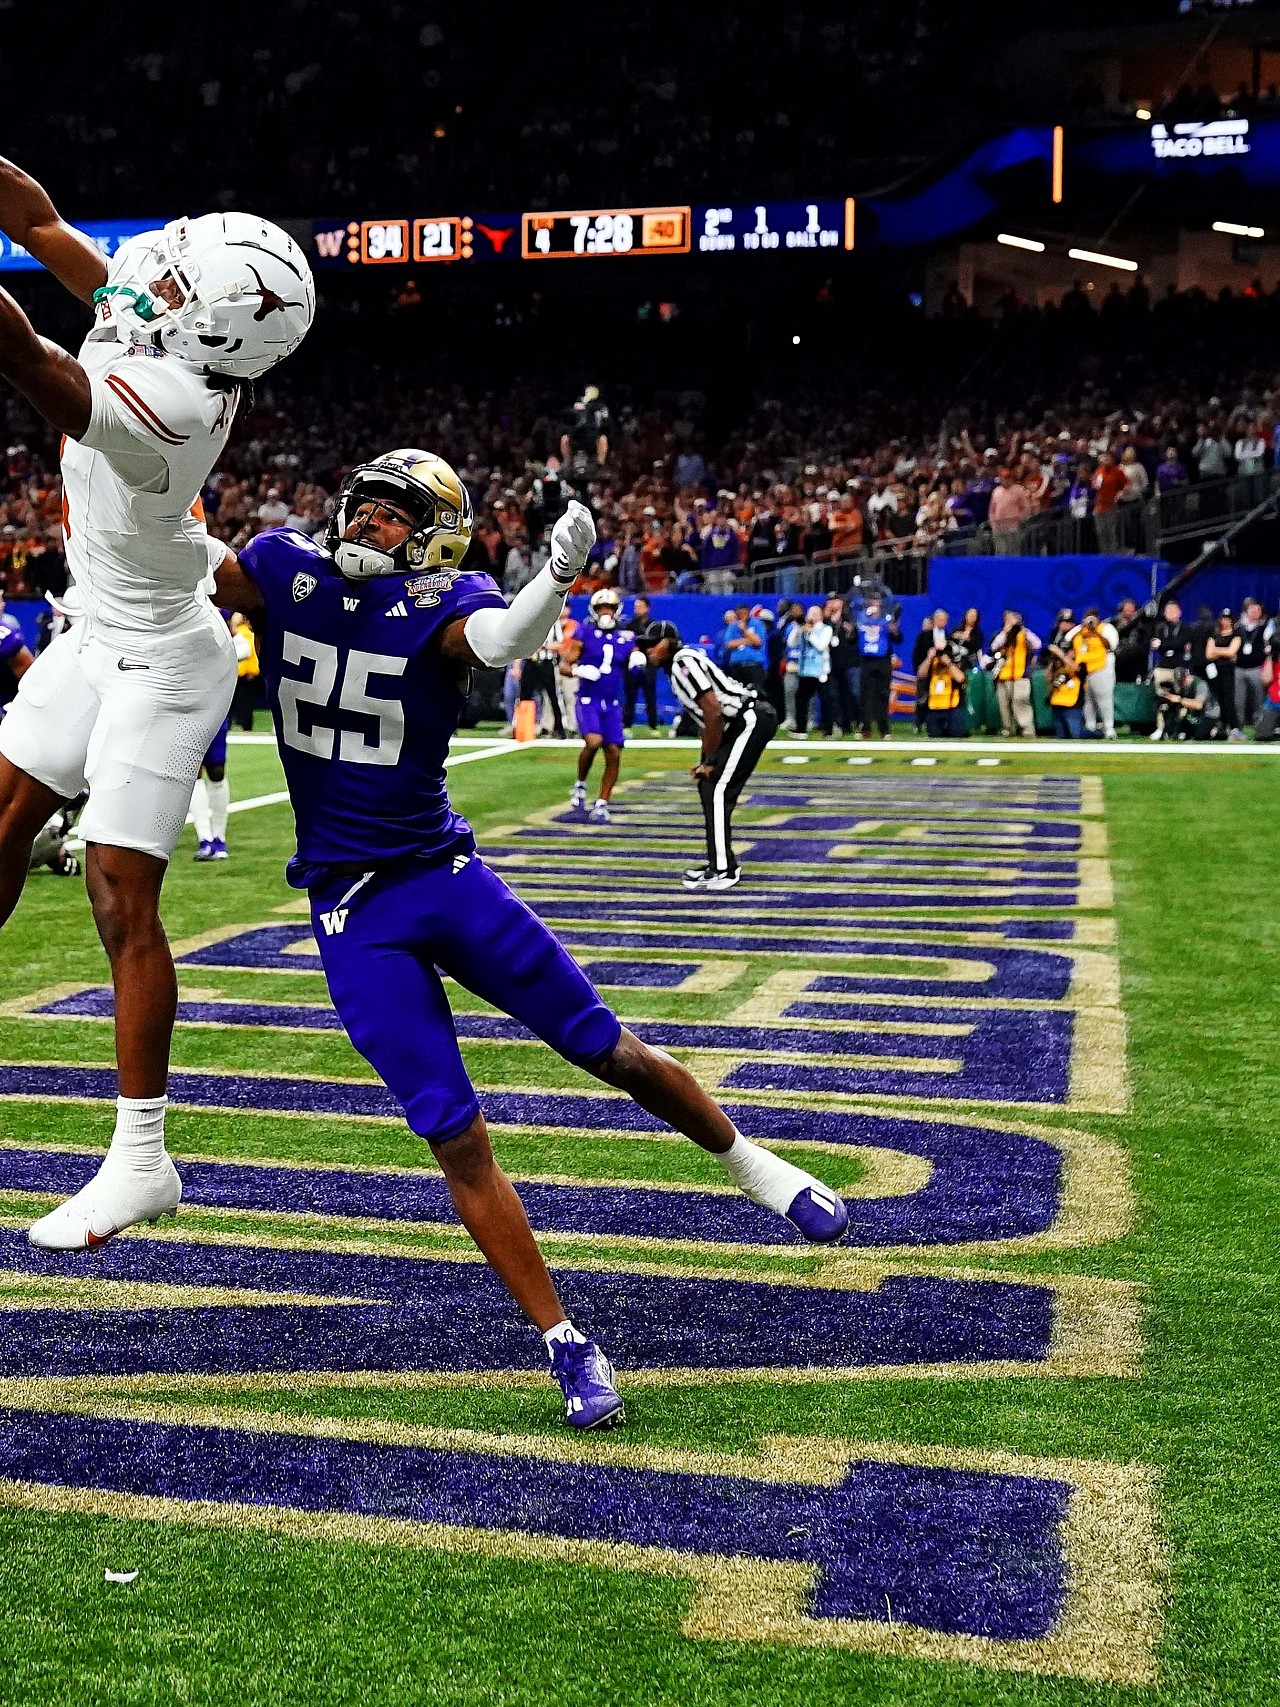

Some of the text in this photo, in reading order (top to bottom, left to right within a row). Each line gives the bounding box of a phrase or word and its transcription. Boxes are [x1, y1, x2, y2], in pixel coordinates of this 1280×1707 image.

[1152, 135, 1250, 157] TACO BELL
[535, 228, 550, 253] 4
[570, 213, 633, 254] 7:28
[755, 206, 768, 233] 1
[806, 205, 820, 233] 1
[315, 229, 345, 257] W
[369, 224, 403, 259] 34
[423, 222, 454, 257] 21
[343, 597, 360, 612] W
[600, 643, 613, 674] 1
[278, 630, 407, 764] 25
[319, 909, 348, 936] W
